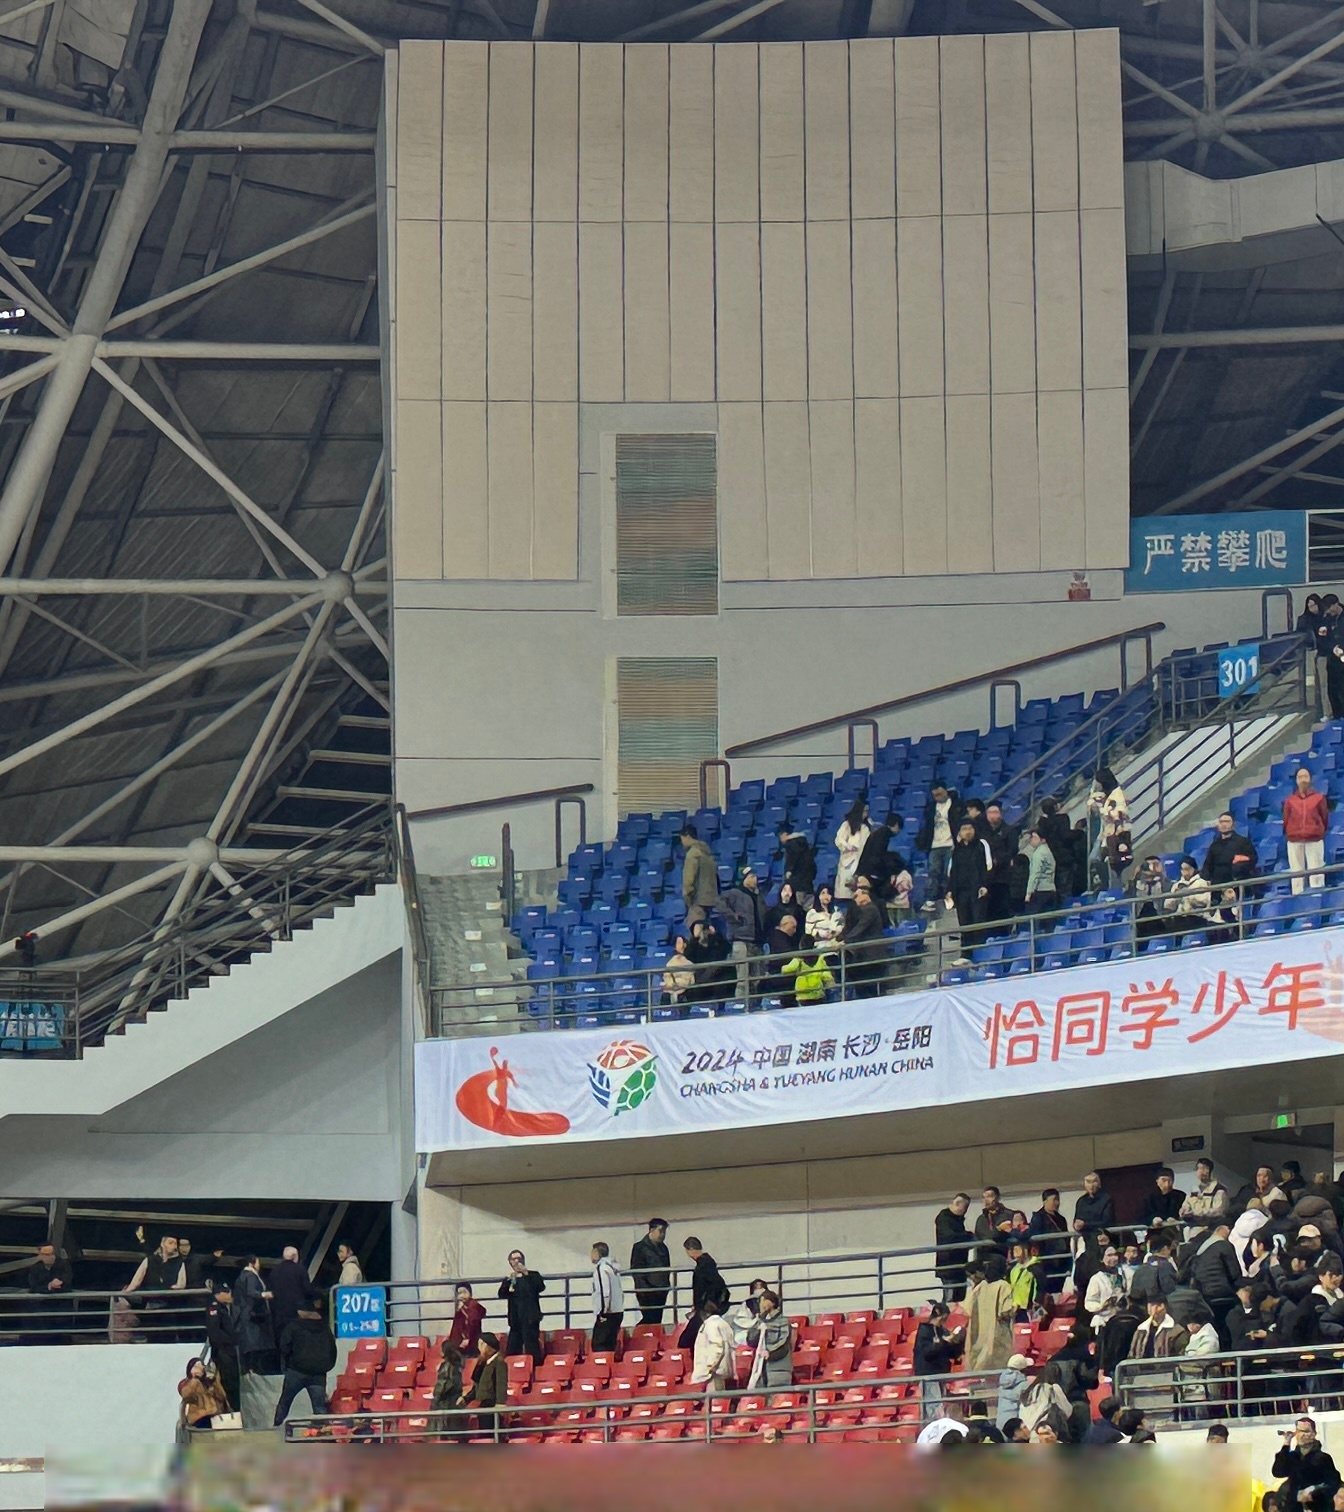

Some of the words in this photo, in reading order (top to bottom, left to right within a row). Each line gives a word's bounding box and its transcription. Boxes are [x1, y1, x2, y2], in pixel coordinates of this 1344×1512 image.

[1143, 528, 1288, 575] 严禁攀爬
[1221, 656, 1258, 687] 301
[984, 961, 1326, 1070] 恰同学少年
[680, 1047, 745, 1076] 2024
[752, 1043, 793, 1070] 中国
